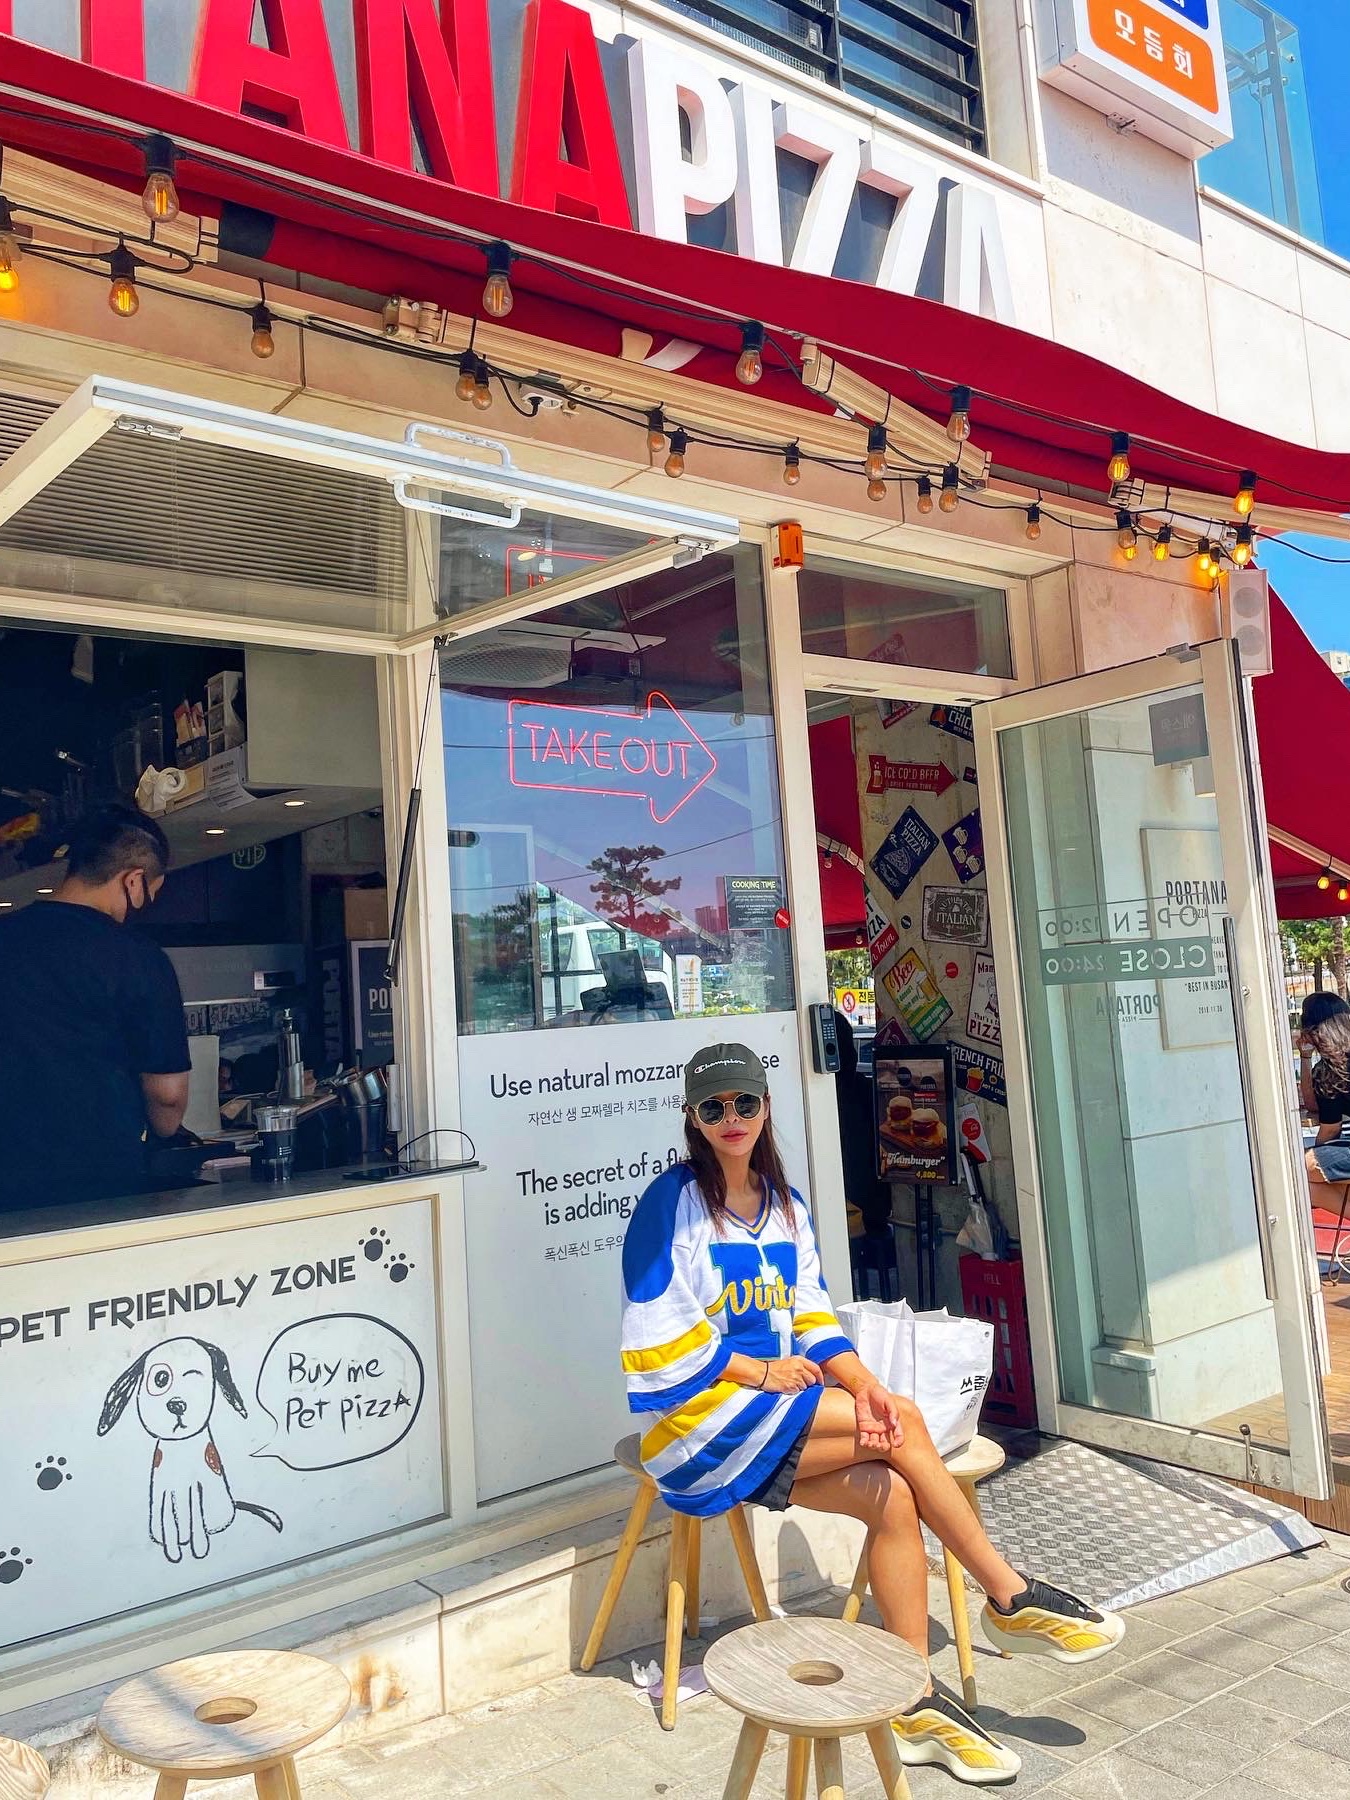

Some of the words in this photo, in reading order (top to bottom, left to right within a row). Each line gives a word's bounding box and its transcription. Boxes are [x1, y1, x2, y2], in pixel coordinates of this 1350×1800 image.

[1114, 8, 1193, 80] 모듬회
[627, 38, 1016, 327] PIZZA
[948, 710, 974, 731] CHIC
[521, 723, 614, 770] TAKE
[619, 737, 692, 779] OUT
[901, 828, 921, 856] PIZZA
[904, 818, 931, 850] ITALIAN
[731, 881, 760, 890] COOKING
[761, 880, 777, 890] TIME
[1165, 880, 1228, 906] PORTANA
[936, 911, 977, 926] ITALIAN
[490, 1073, 533, 1098] Use
[538, 1062, 610, 1094] natural
[615, 1063, 686, 1085] mozzar
[694, 1058, 746, 1074] Champion
[528, 1109, 563, 1126] 자연산
[566, 1106, 577, 1122] 생
[580, 1101, 625, 1118] 모짜렐라
[627, 1097, 658, 1113] 치즈를
[516, 1170, 558, 1196] The
[562, 1156, 625, 1190] secret
[629, 1151, 649, 1177] of
[652, 1159, 662, 1175] a
[544, 1202, 560, 1226] is
[564, 1191, 632, 1224] adding
[544, 1240, 590, 1262] 폭신폭신
[0, 1307, 70, 1347] PET
[88, 1273, 258, 1331] FRIENDLY
[270, 1255, 357, 1296] ZONE
[287, 1352, 342, 1387] Buy
[347, 1357, 385, 1382] me
[285, 1399, 330, 1435] Pet
